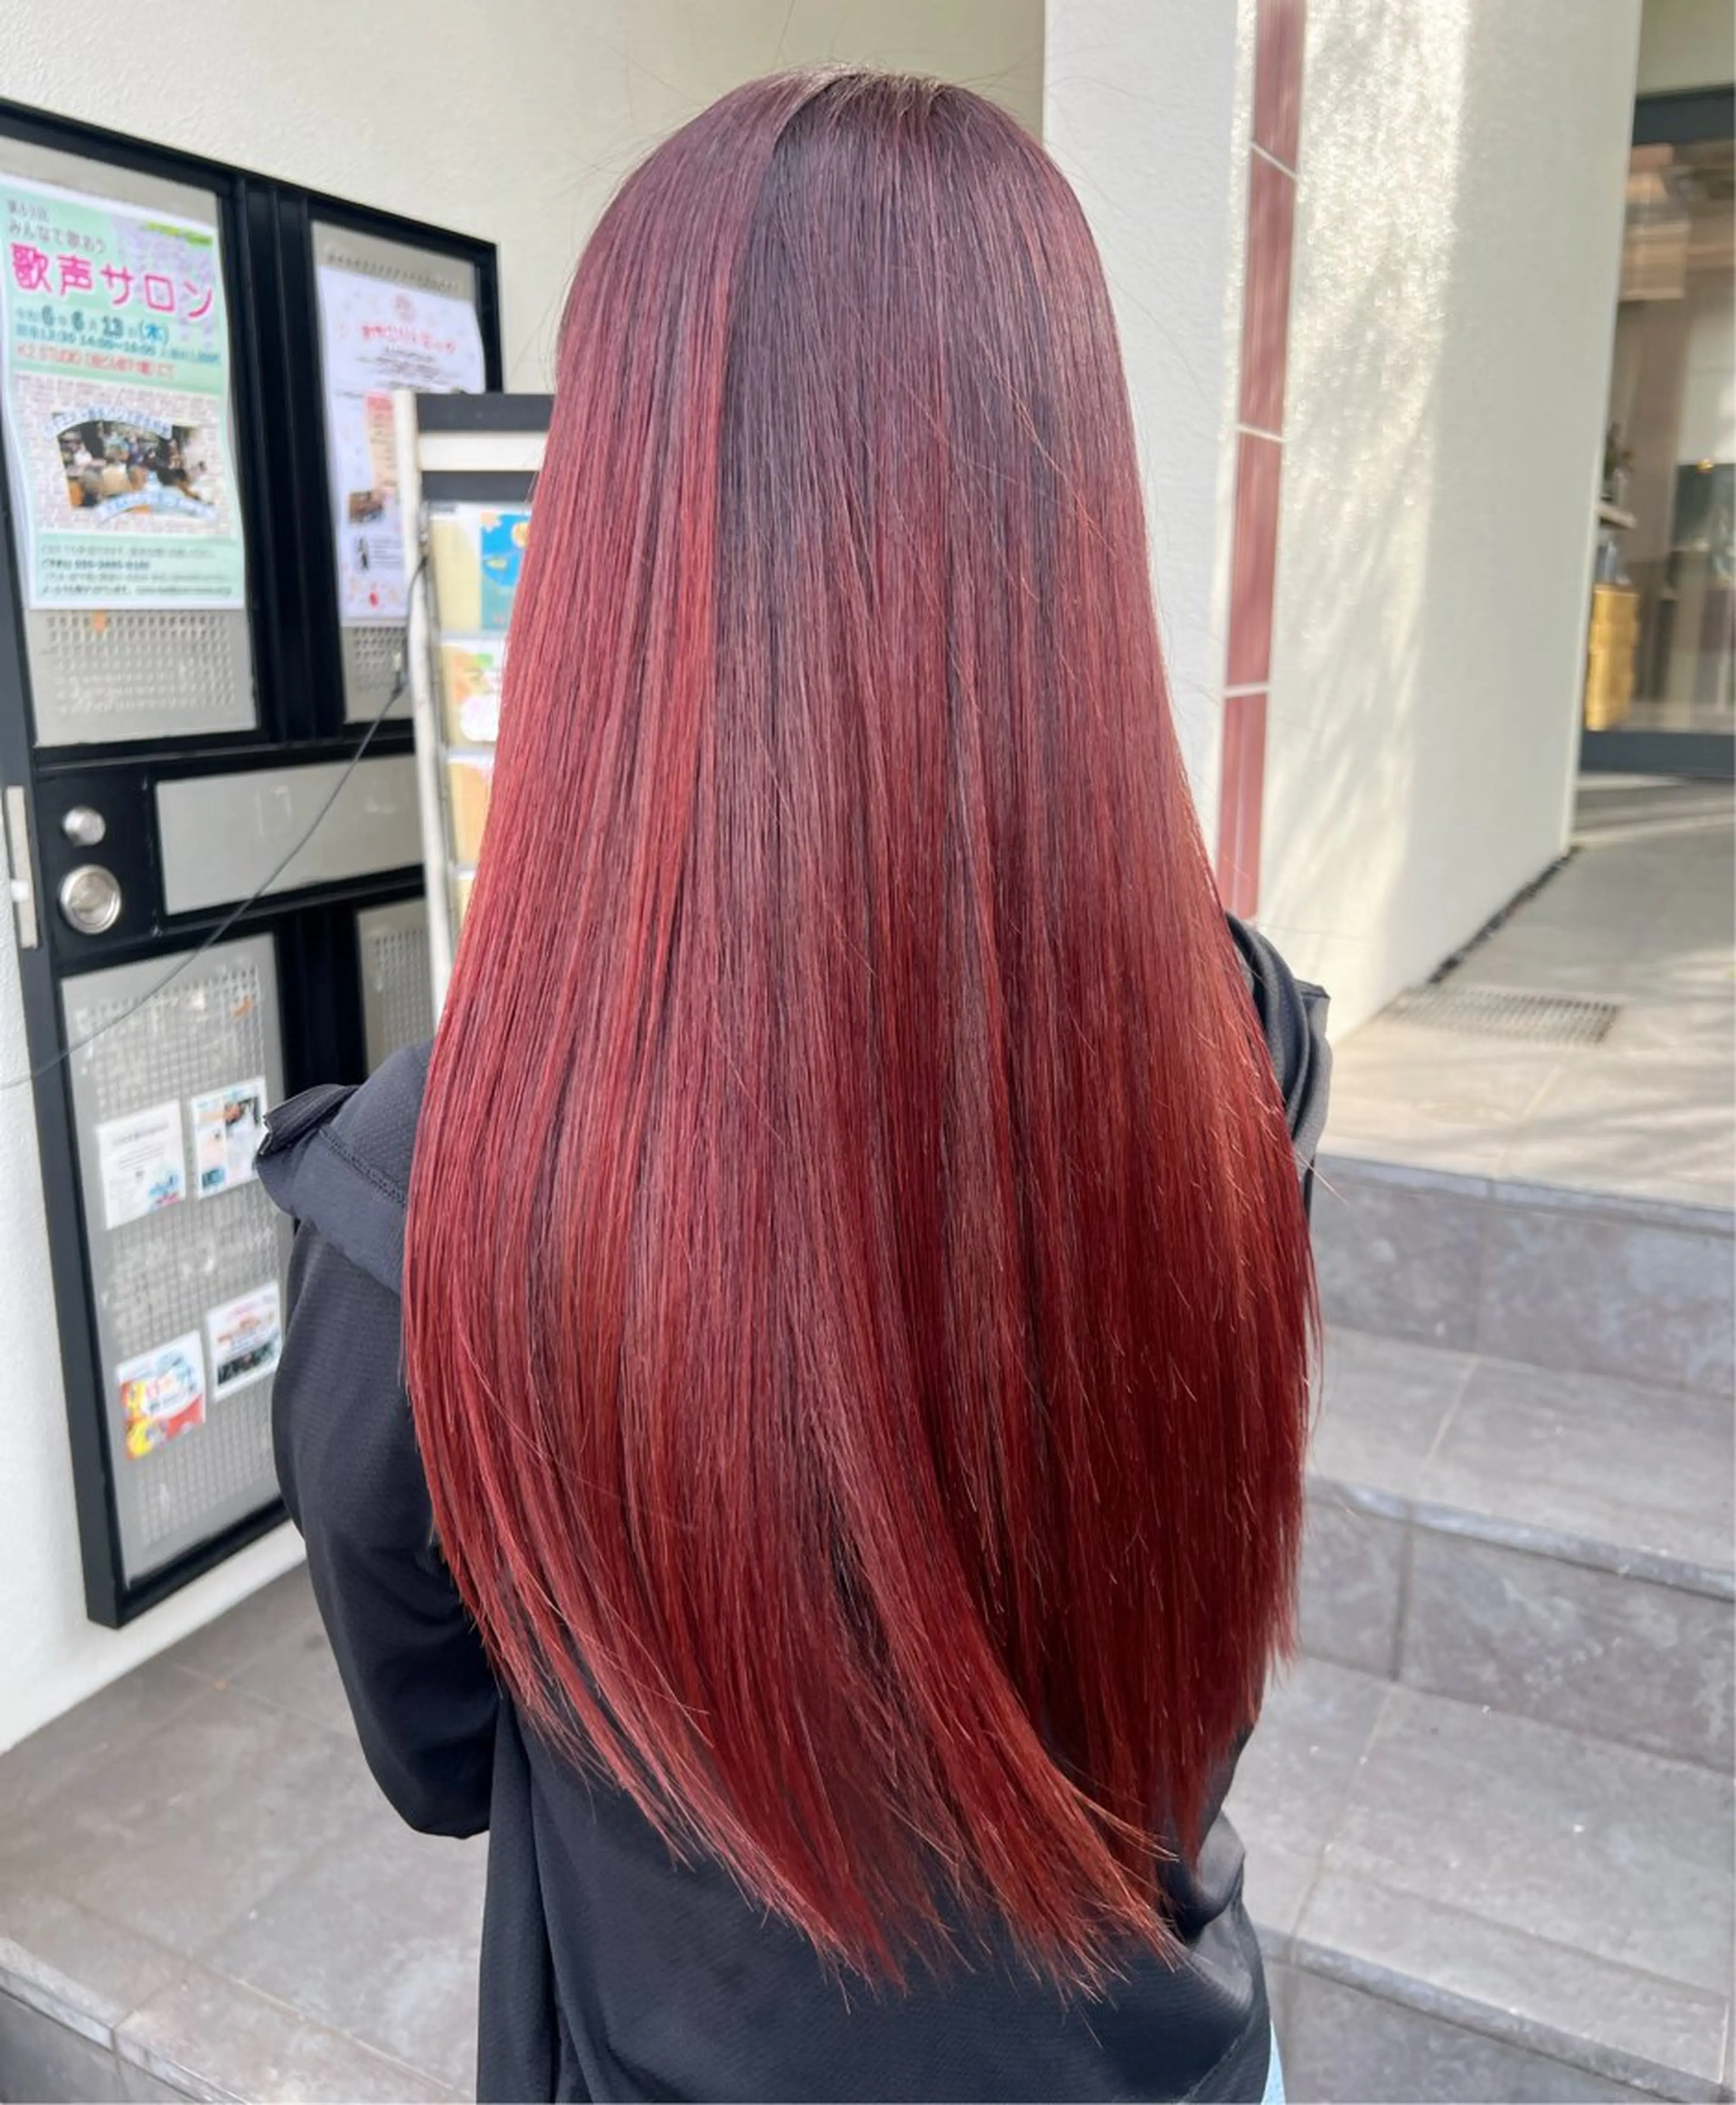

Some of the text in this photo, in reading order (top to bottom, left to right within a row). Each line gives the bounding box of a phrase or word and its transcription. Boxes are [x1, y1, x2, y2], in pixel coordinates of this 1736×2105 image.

[10, 241, 212, 318] 歌声サロン
